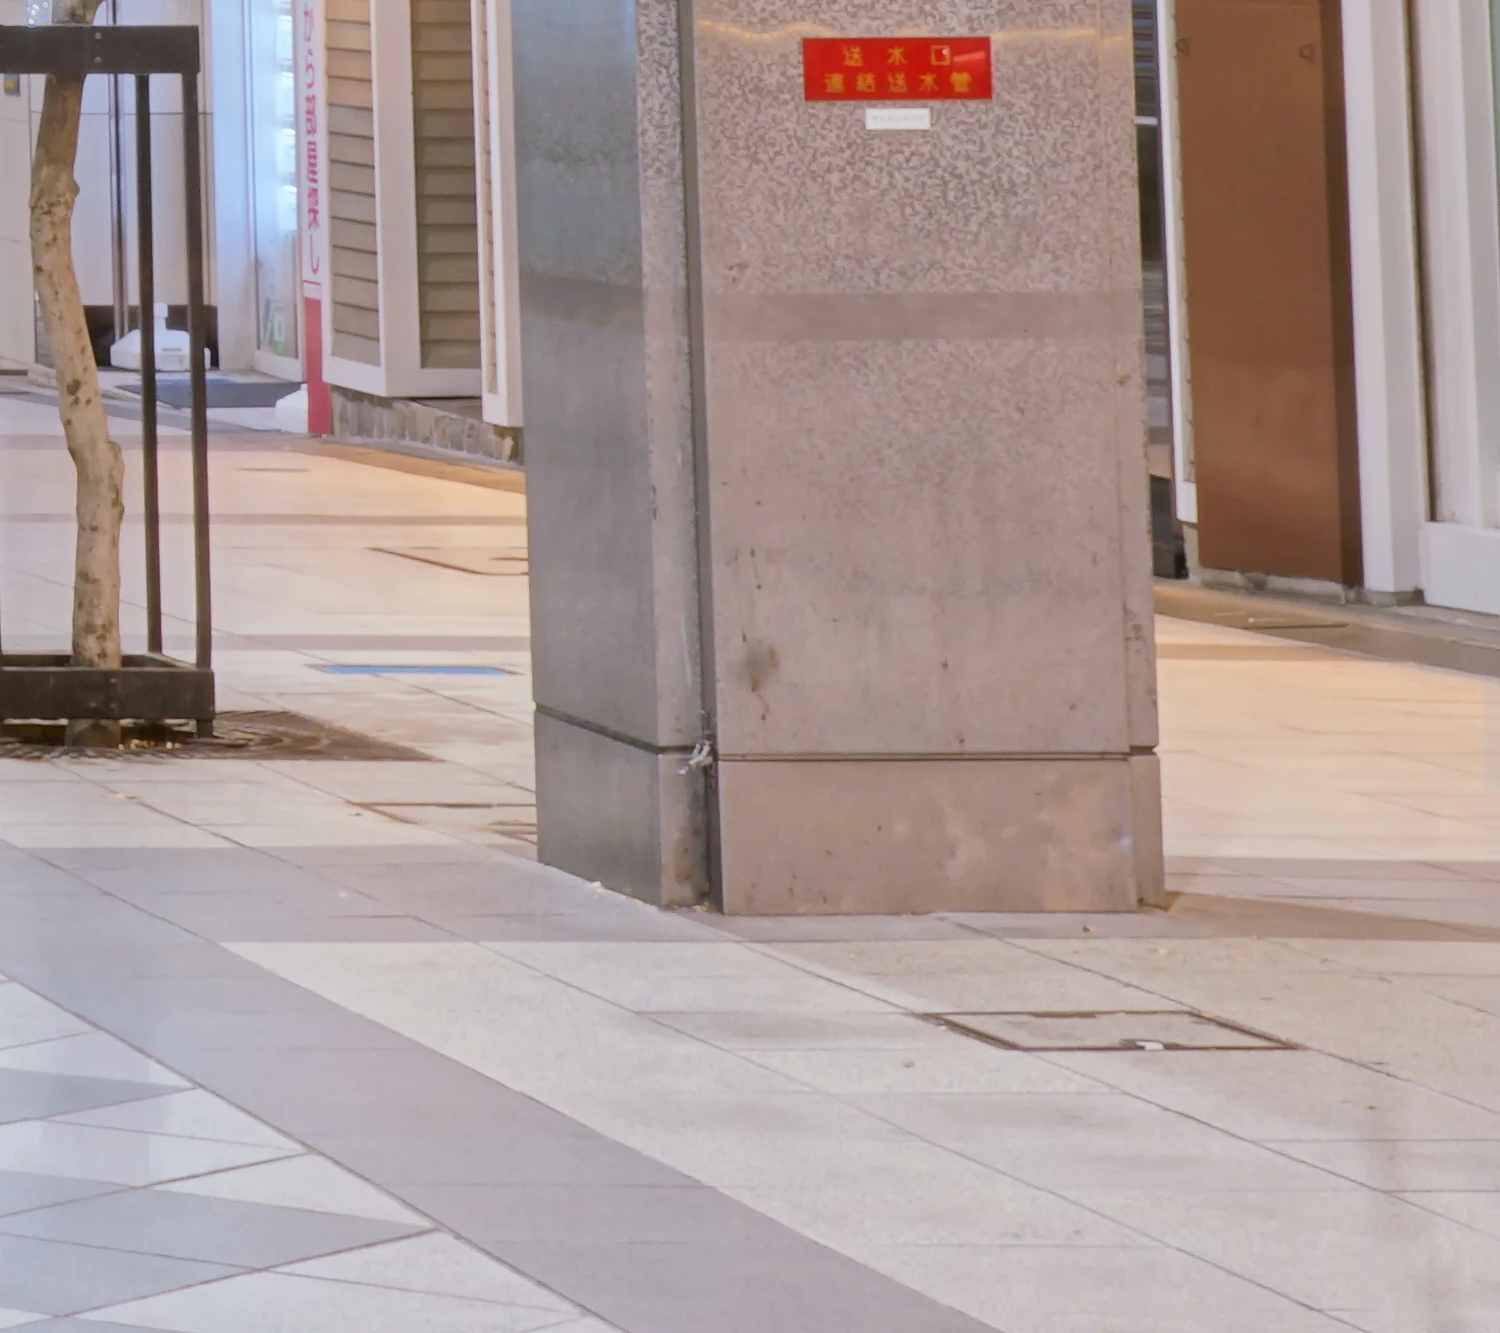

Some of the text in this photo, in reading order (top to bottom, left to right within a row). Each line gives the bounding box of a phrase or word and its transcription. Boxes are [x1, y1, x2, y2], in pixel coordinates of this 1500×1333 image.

[842, 44, 951, 67] 送水口
[824, 71, 973, 94] 連結送水管
